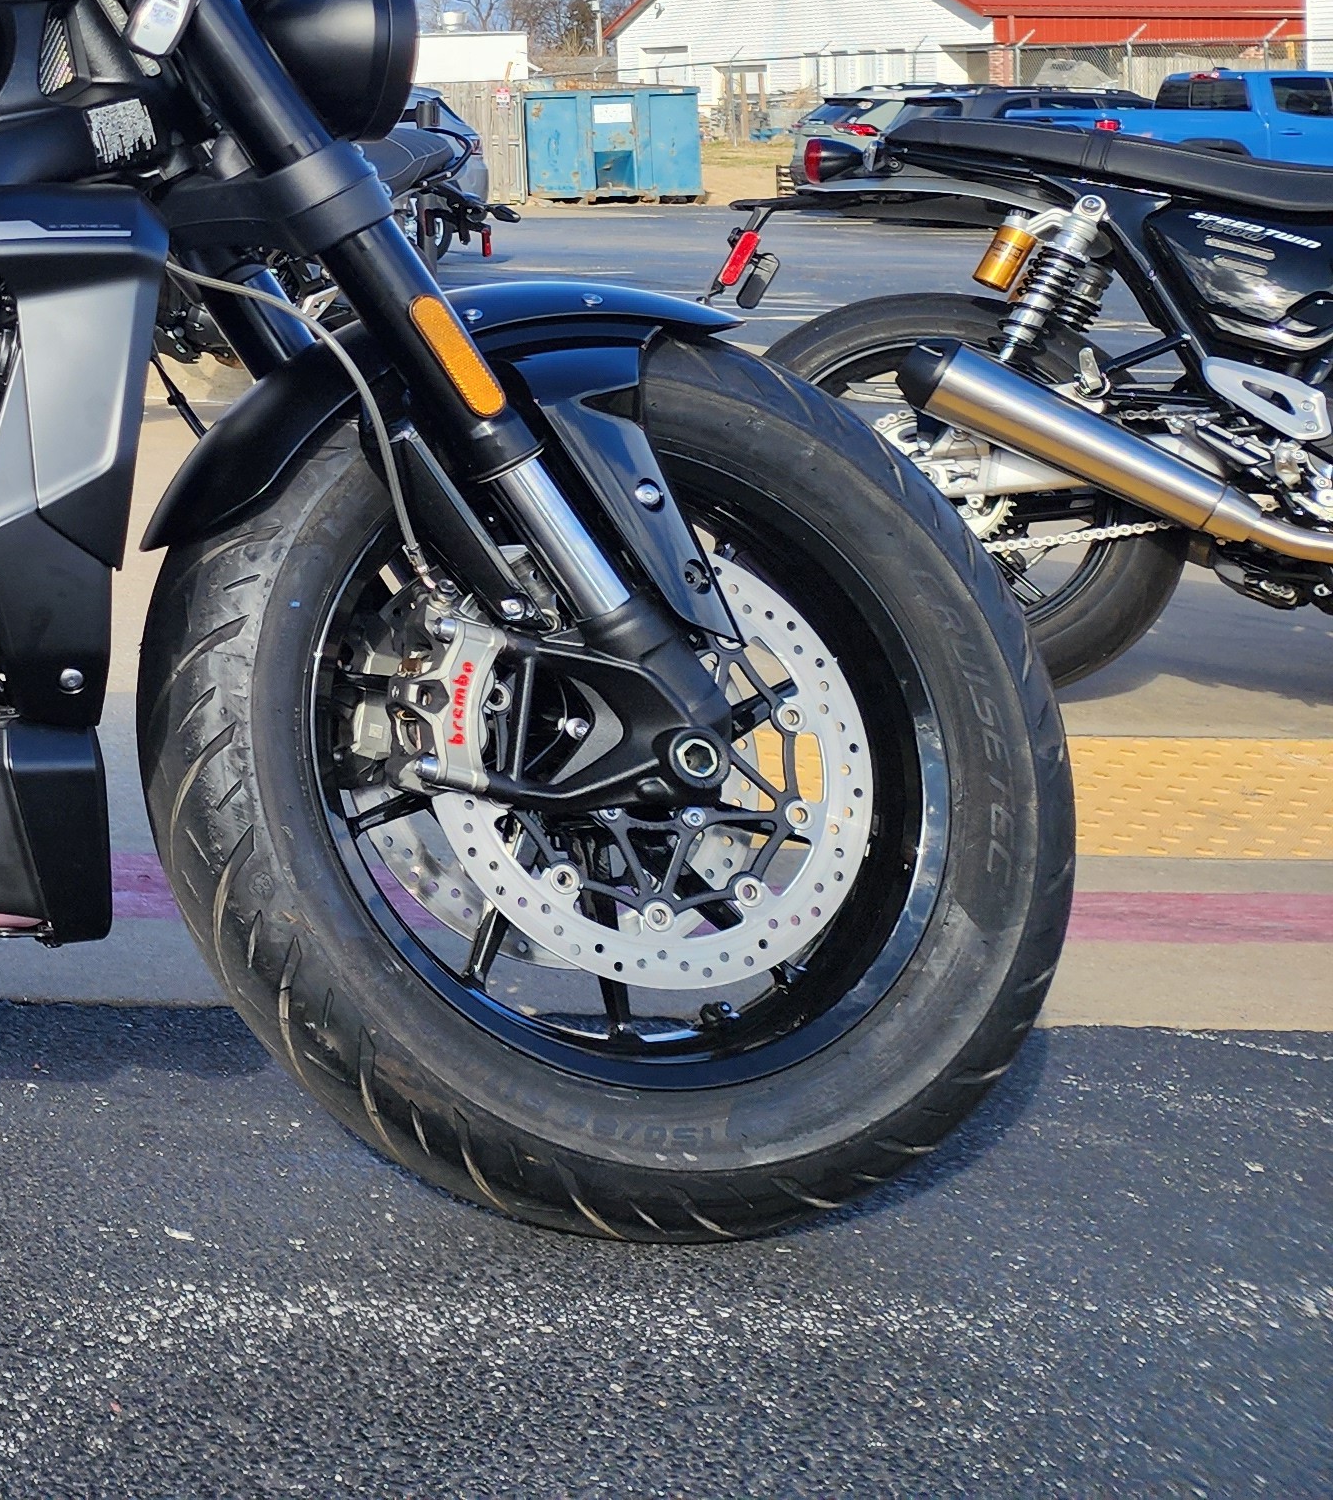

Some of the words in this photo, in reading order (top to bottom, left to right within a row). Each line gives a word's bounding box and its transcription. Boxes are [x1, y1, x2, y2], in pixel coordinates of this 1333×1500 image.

[1188, 211, 1266, 233] SPEED
[447, 661, 474, 745] brembo
[907, 567, 1017, 888] CRUISETEC
